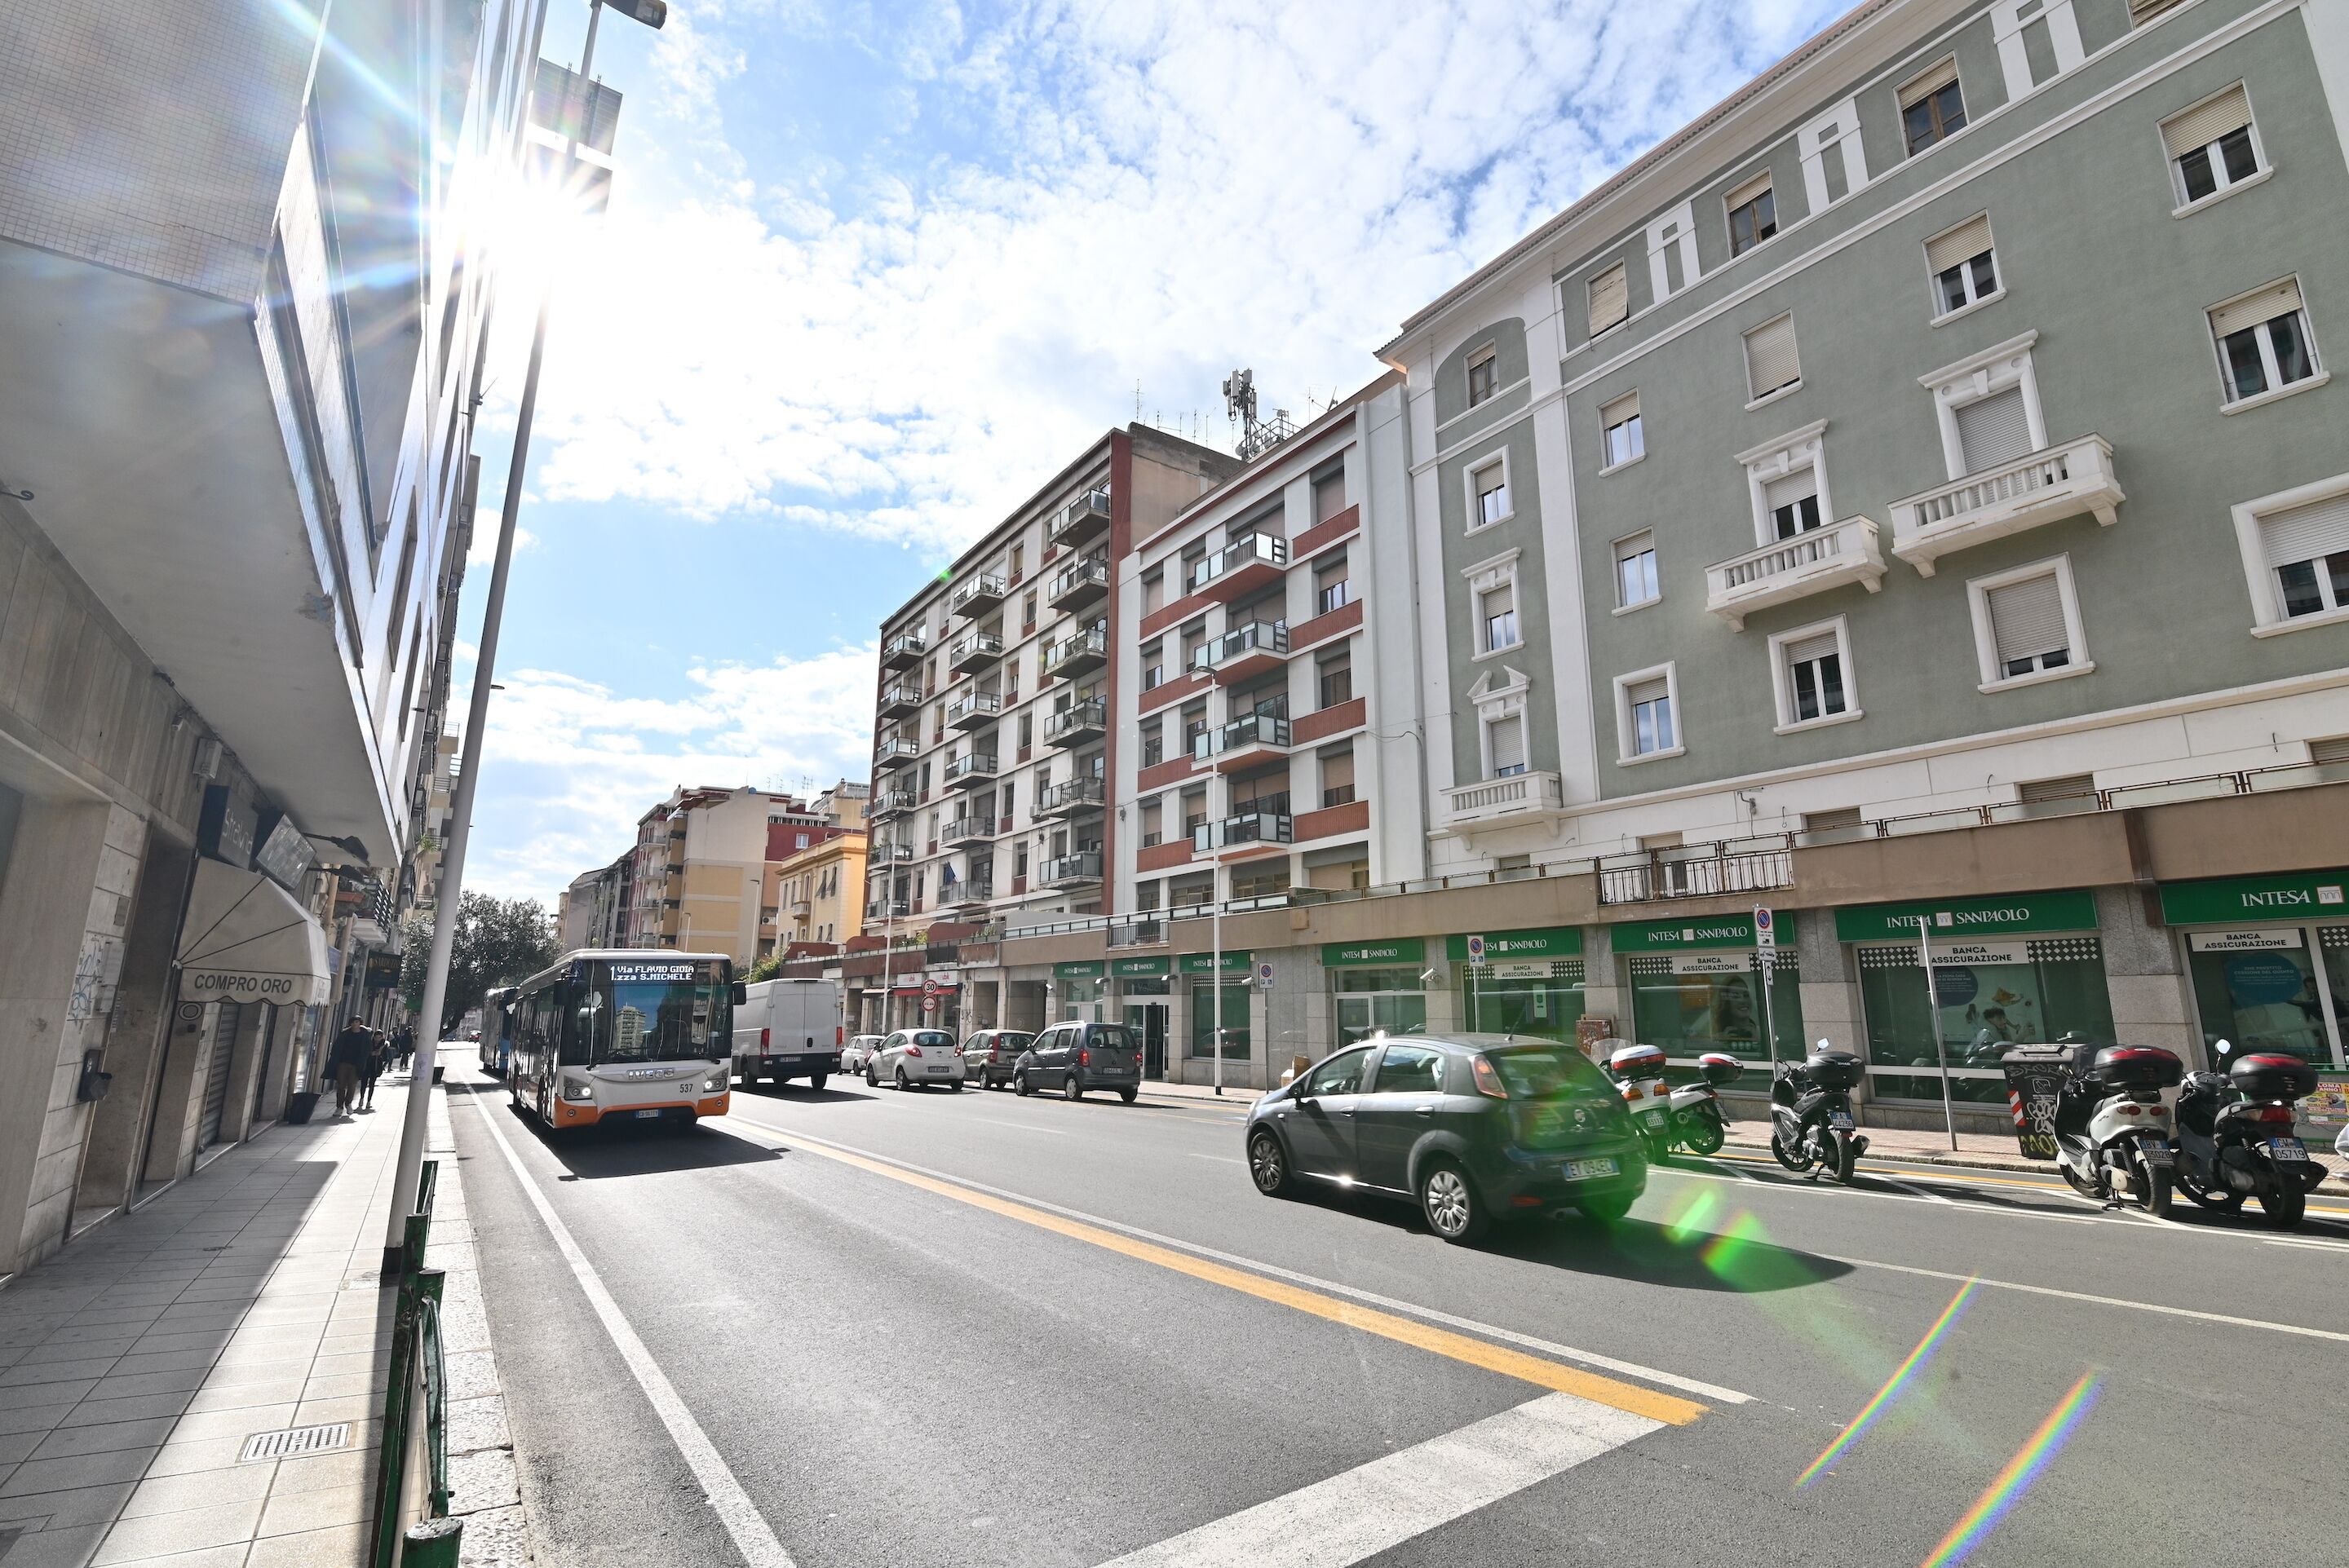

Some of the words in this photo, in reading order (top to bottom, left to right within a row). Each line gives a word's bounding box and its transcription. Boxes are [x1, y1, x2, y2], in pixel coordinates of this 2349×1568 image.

[2241, 890, 2311, 907] INTESA
[1956, 908, 2029, 924] SANPAOLO
[1648, 930, 1679, 941] INTESA
[1696, 926, 1747, 939] SANPAOLO
[1509, 939, 1547, 949] SANPAOLO
[2205, 940, 2287, 949] ASSICURAZIONE
[1342, 951, 1360, 959] INTESA
[1931, 954, 2012, 963] ASSICURAZIONE
[617, 965, 633, 974] Via
[635, 965, 667, 974] FLAVIO
[670, 965, 694, 974] GIOIA
[640, 973, 692, 981] S.MICHELE
[195, 974, 257, 992] COMPRO
[261, 978, 292, 993] ORO
[628, 1069, 674, 1080] IVECO
[679, 1084, 693, 1093] 537
[2275, 1150, 2306, 1159] 05719
